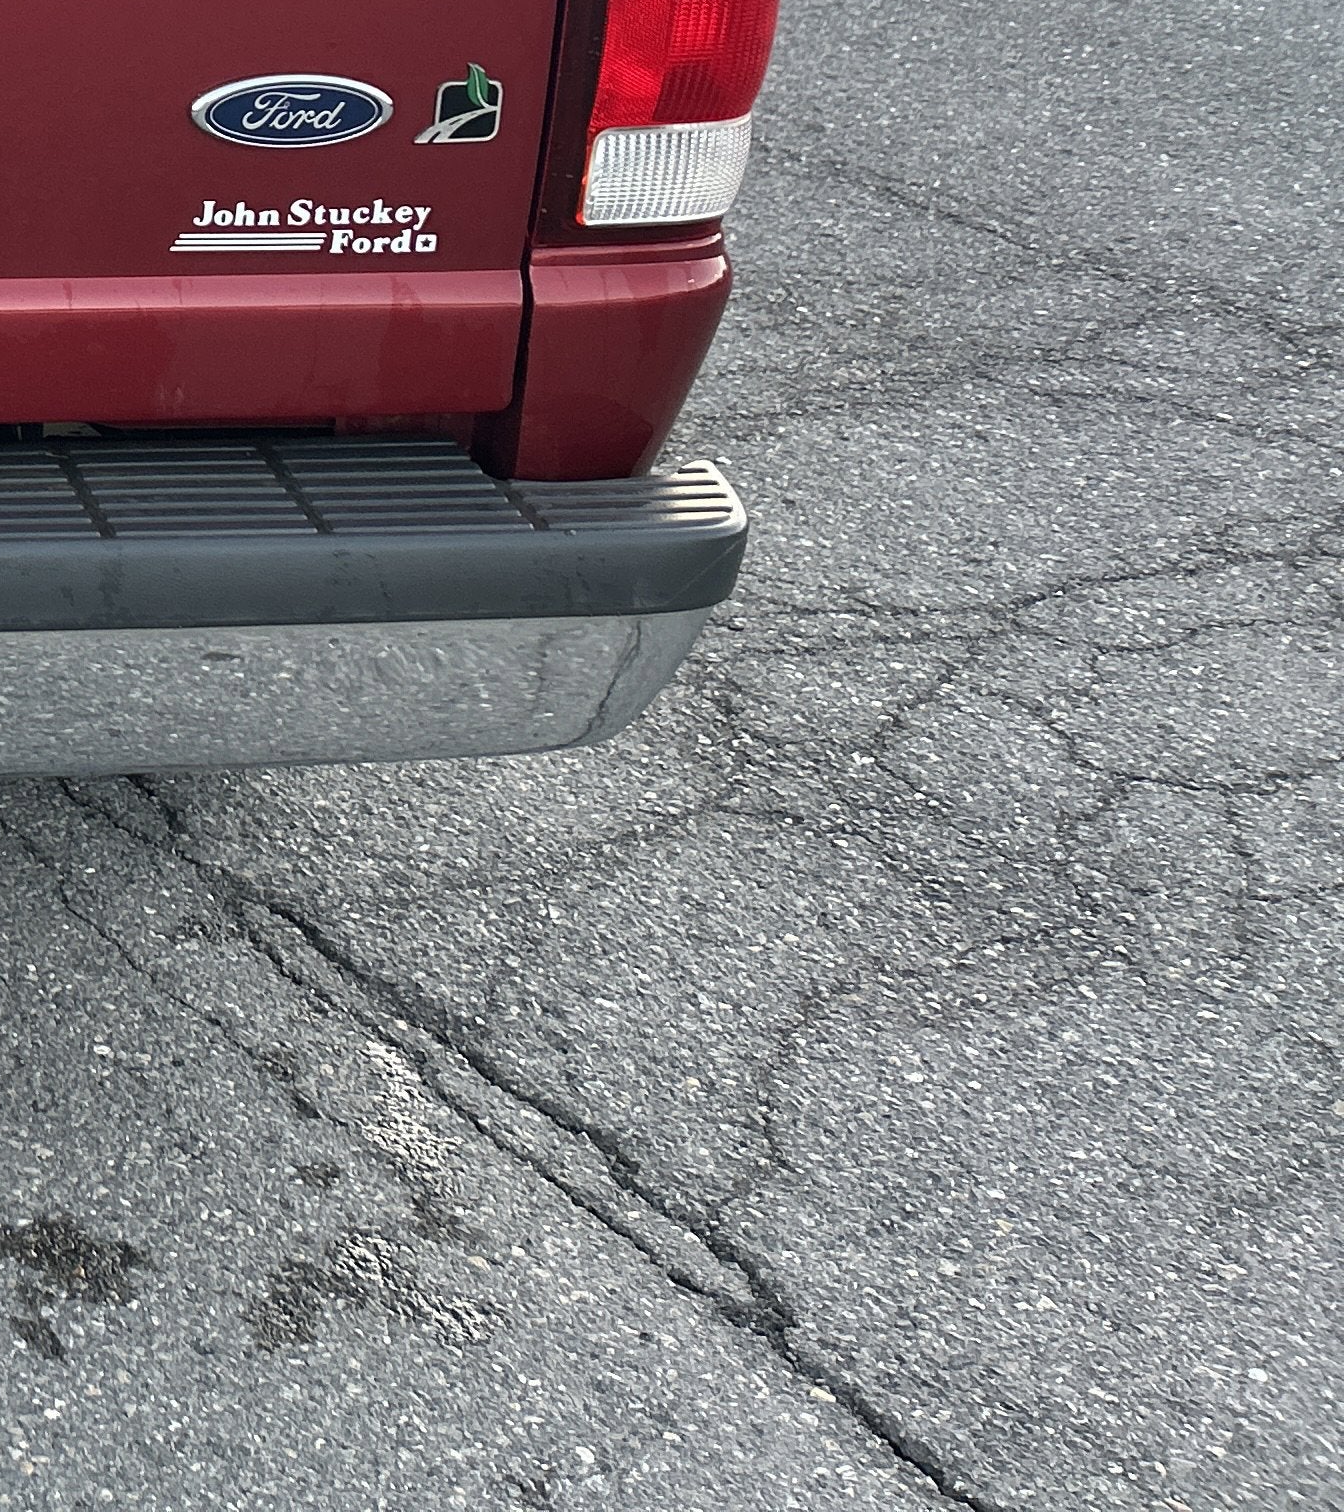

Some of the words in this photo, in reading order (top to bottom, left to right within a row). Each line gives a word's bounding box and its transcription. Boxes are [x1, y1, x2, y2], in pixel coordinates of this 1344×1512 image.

[241, 91, 346, 131] Ford
[192, 200, 281, 227] John
[286, 198, 432, 231] Stuckey
[328, 229, 412, 254] Ford
